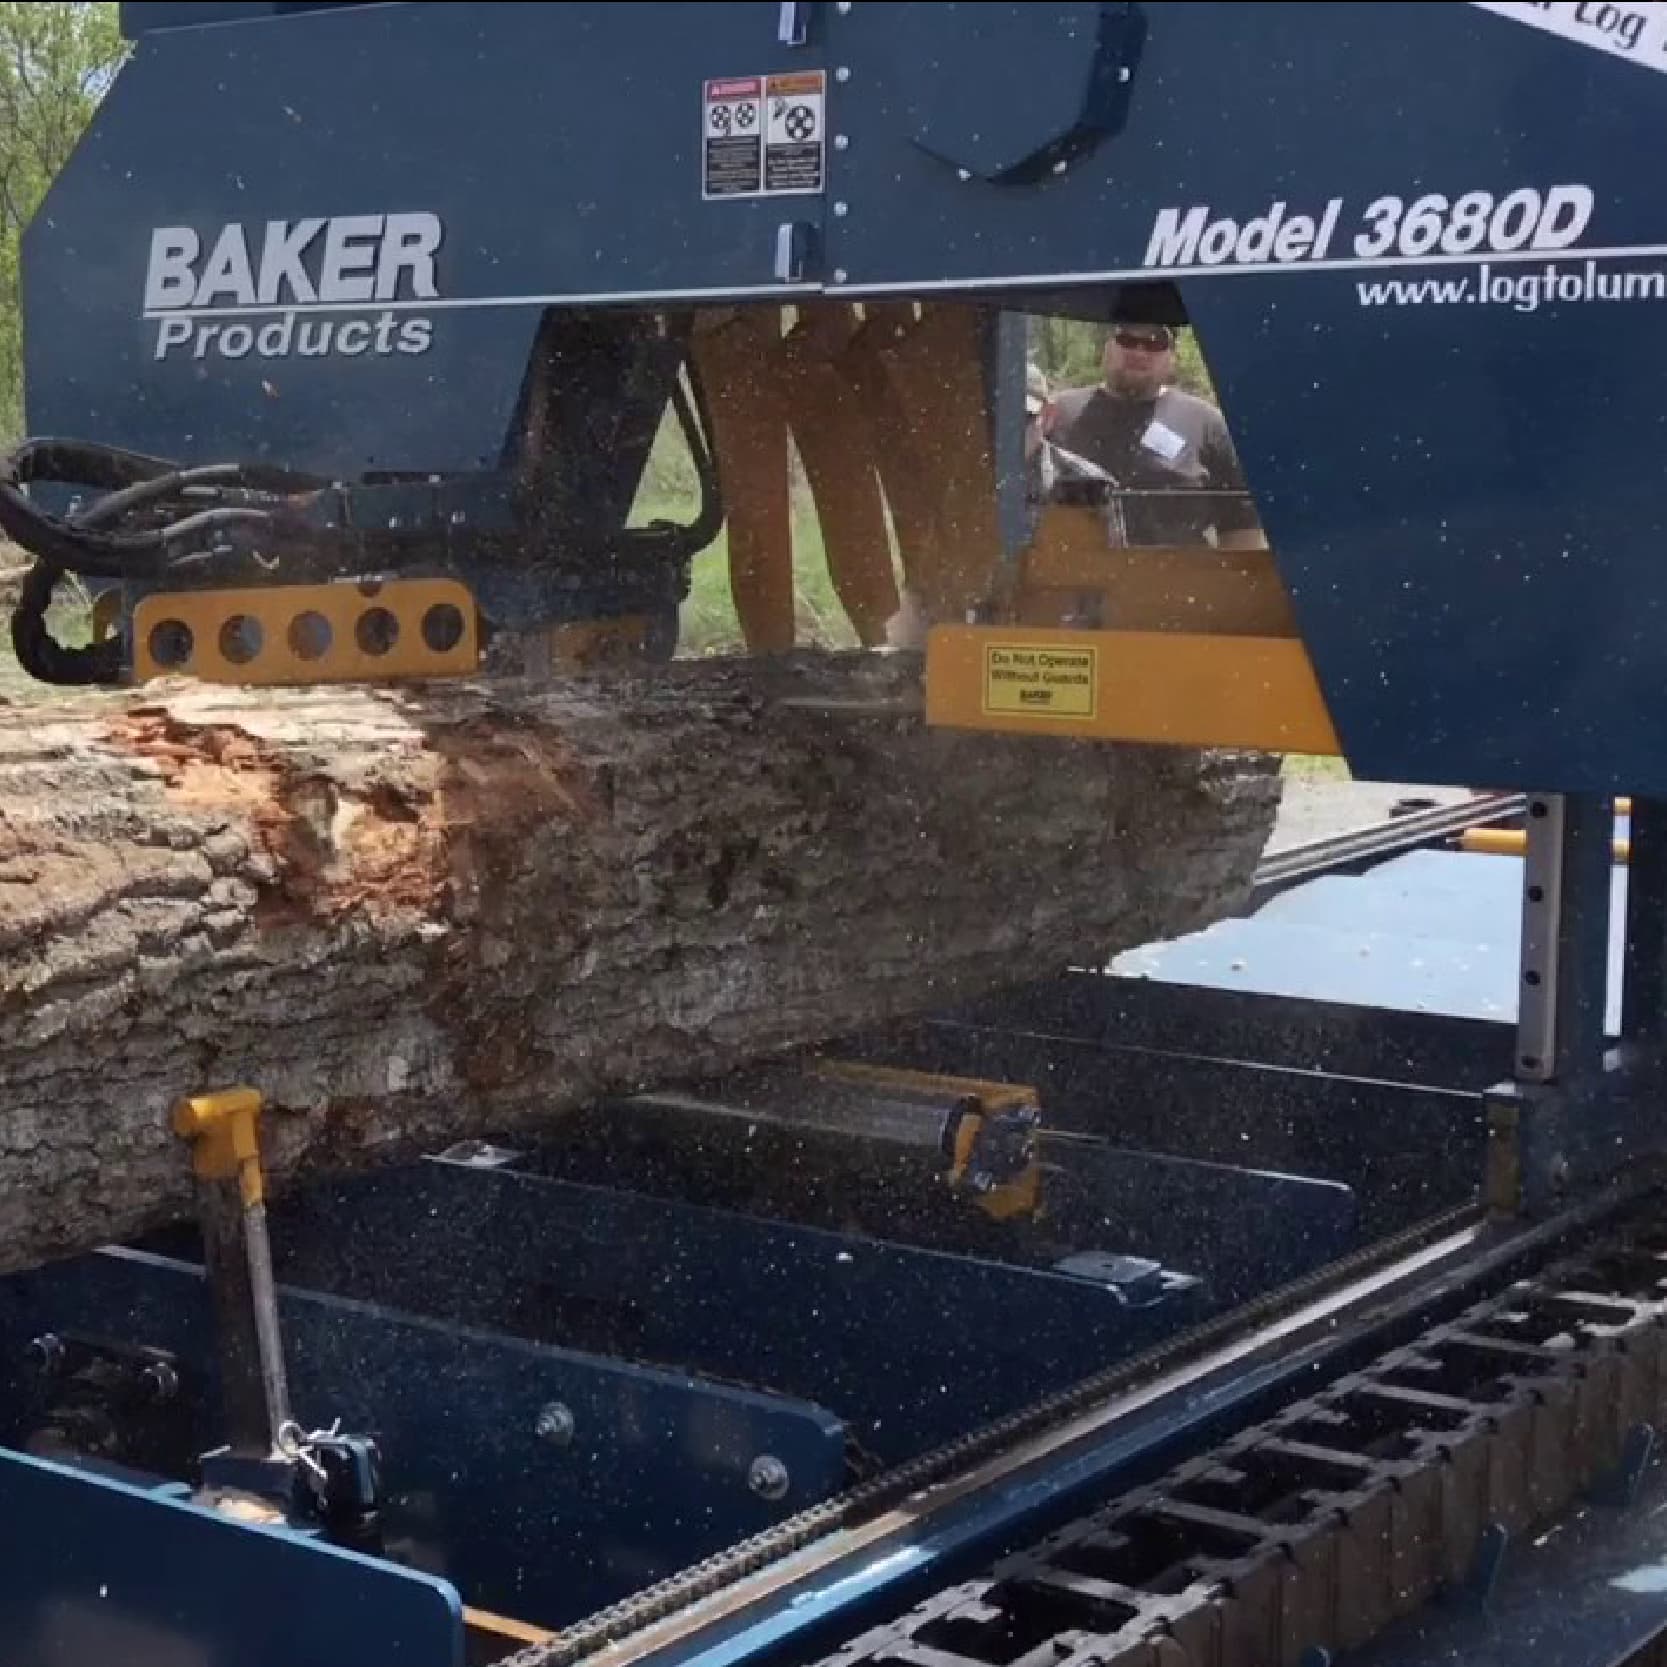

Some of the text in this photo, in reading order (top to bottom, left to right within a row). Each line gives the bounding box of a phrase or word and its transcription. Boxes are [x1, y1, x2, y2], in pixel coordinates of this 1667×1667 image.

[1574, 2, 1648, 49] Log
[1143, 184, 1594, 267] Model 3680D
[144, 211, 442, 309] BAKER
[1356, 260, 1666, 312] www.logtolum
[154, 311, 434, 361] Products
